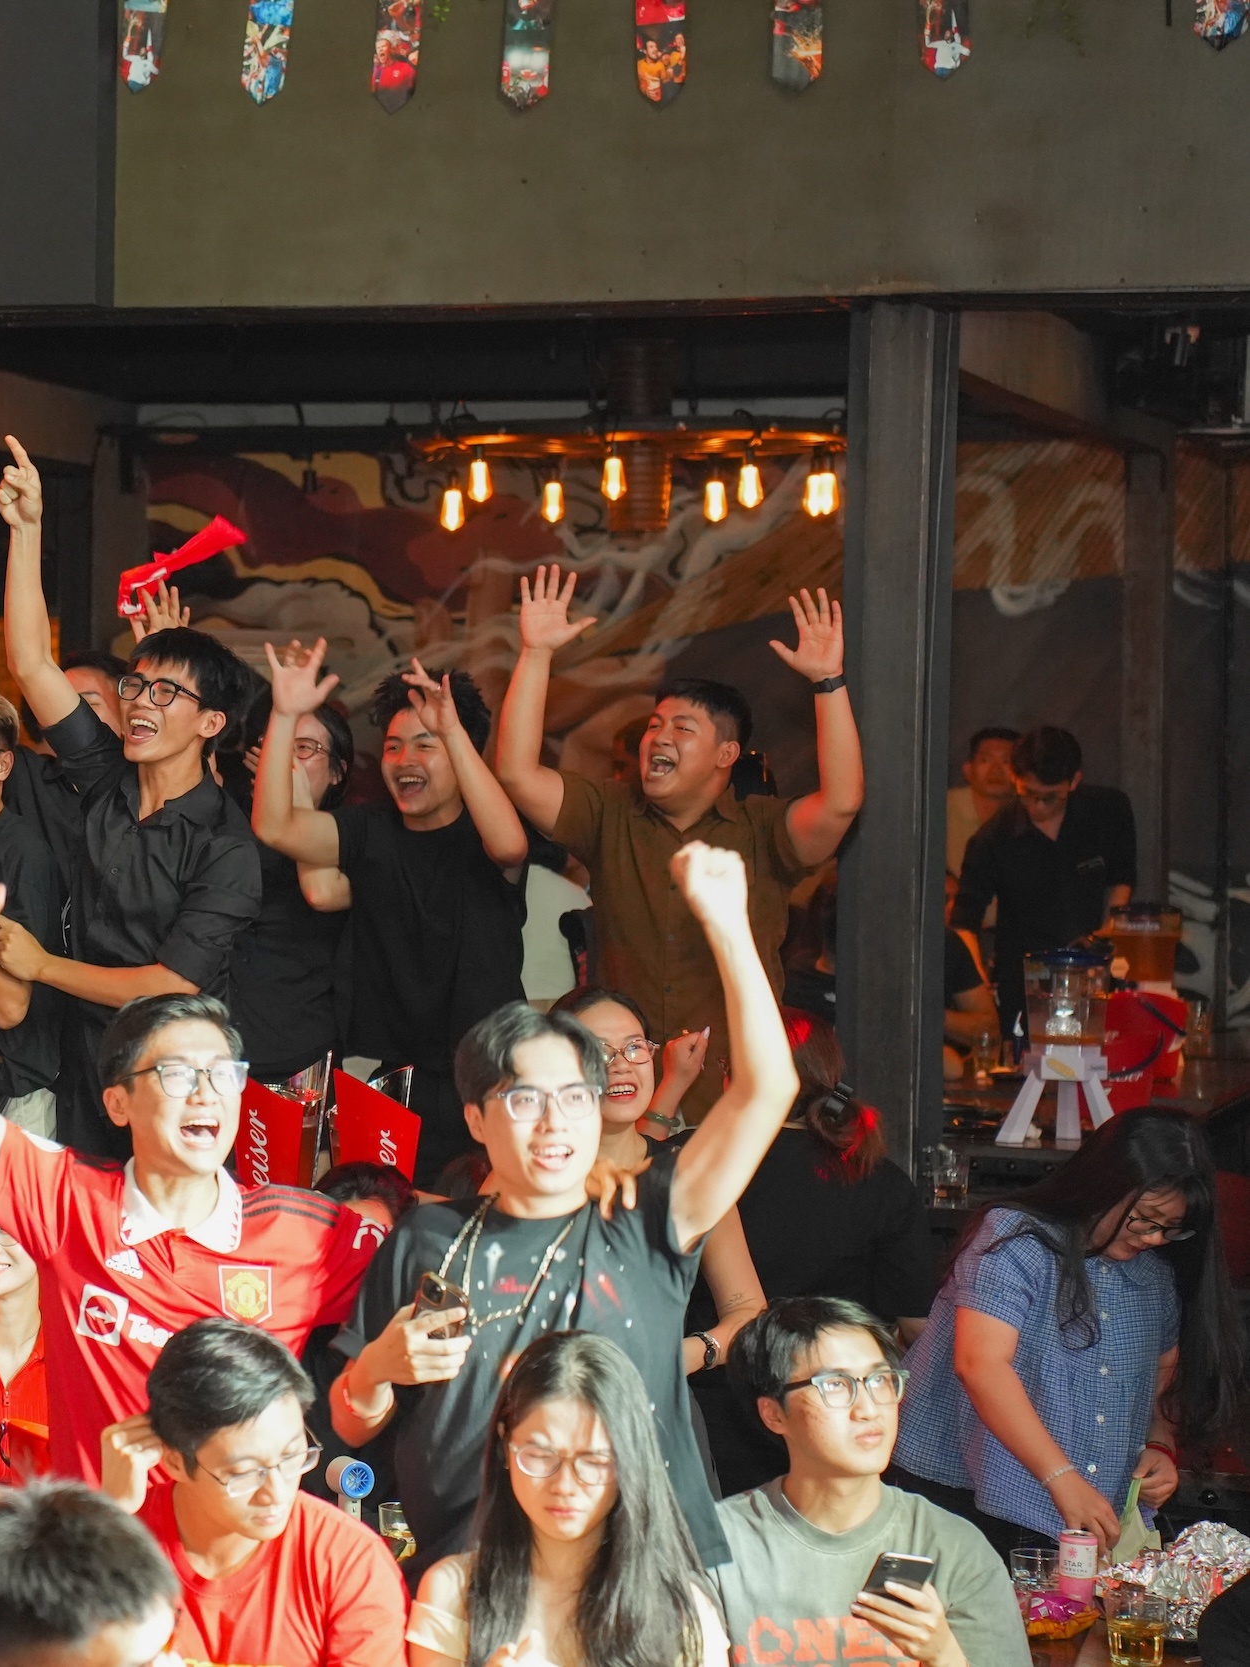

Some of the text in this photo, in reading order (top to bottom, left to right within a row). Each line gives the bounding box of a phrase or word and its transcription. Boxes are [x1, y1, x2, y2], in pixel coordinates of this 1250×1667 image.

[246, 1108, 271, 1188] eiser
[127, 1312, 175, 1349] Tea
[1063, 1559, 1084, 1569] STAR
[733, 1615, 907, 1665] ONE
